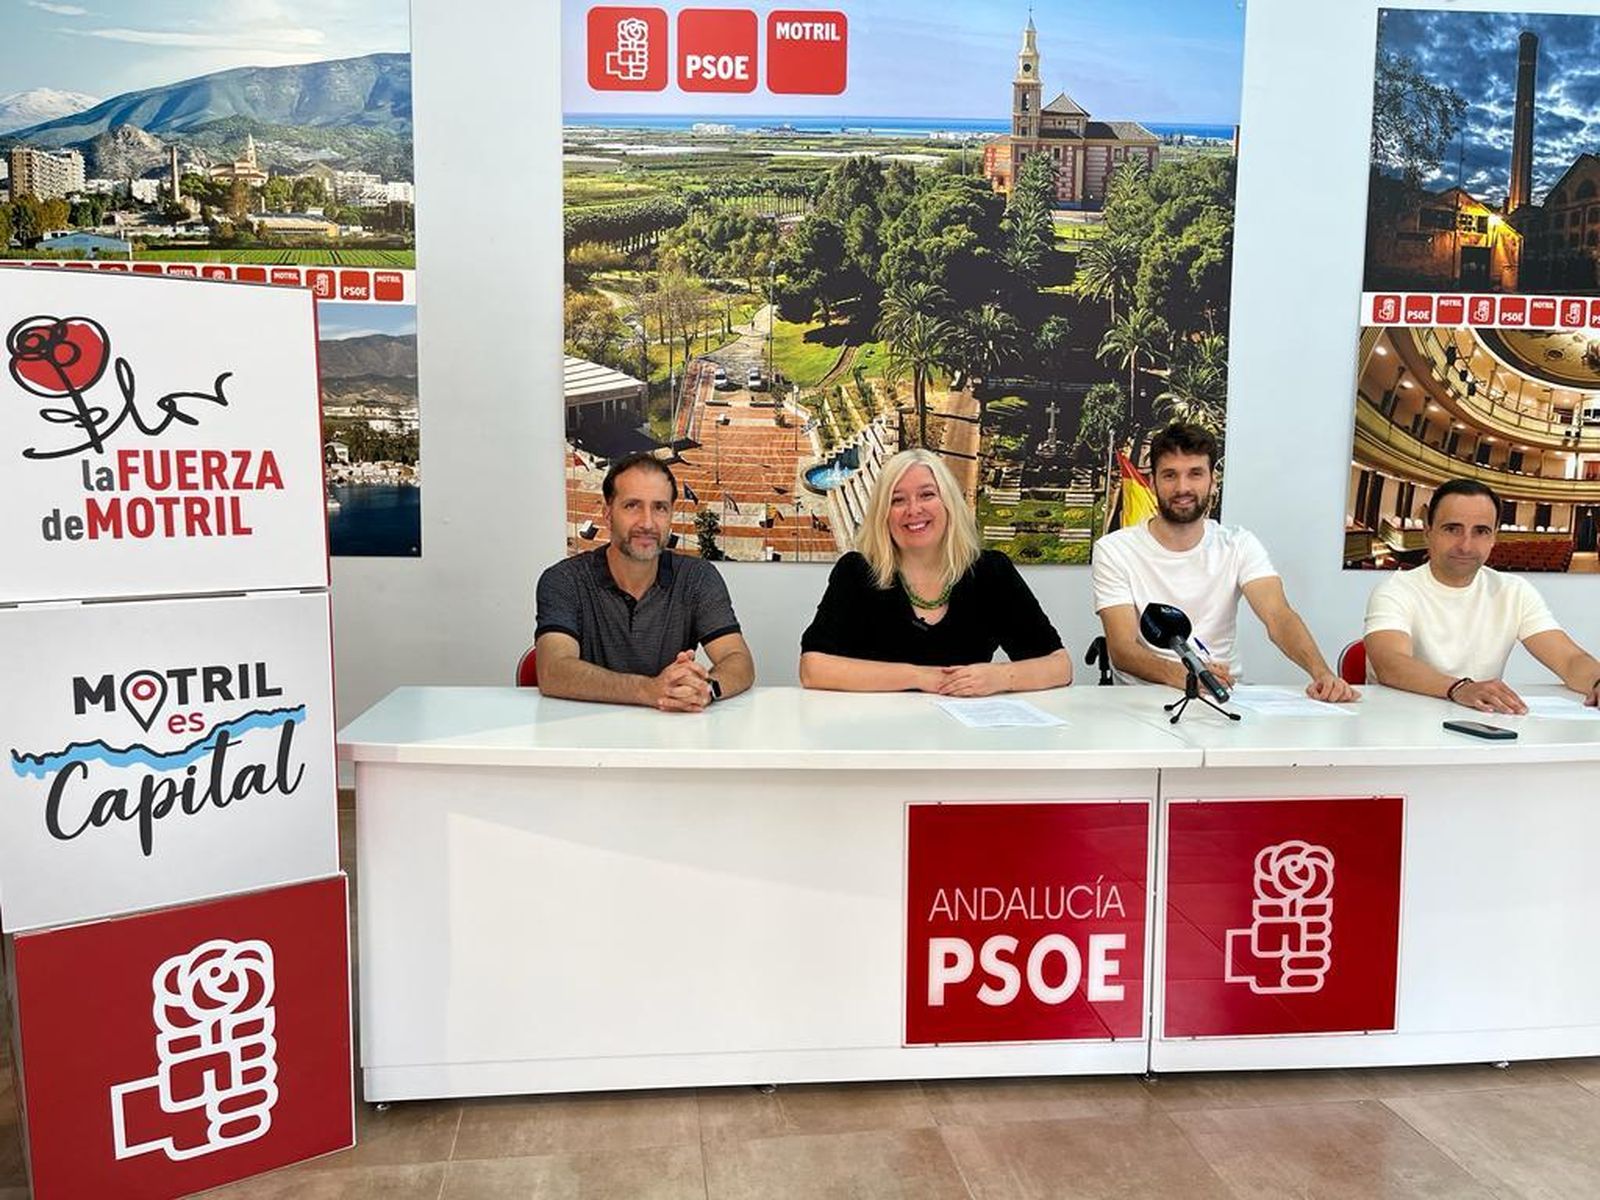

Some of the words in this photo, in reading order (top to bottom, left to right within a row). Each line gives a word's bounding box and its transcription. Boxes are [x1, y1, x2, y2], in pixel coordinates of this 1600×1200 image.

[775, 21, 841, 41] MOTRIL
[685, 54, 749, 81] PSOE
[273, 272, 299, 281] MOTRIL
[376, 275, 401, 284] MOTRIL
[342, 286, 368, 297] PSOE
[1407, 310, 1431, 320] PSOE
[1501, 312, 1524, 322] PSOE
[73, 662, 283, 732] MOTRIL
[167, 712, 206, 734] es
[45, 719, 305, 857] Capital
[928, 875, 1126, 922] ANDALUCÍA
[927, 933, 1126, 1007] PSOE
